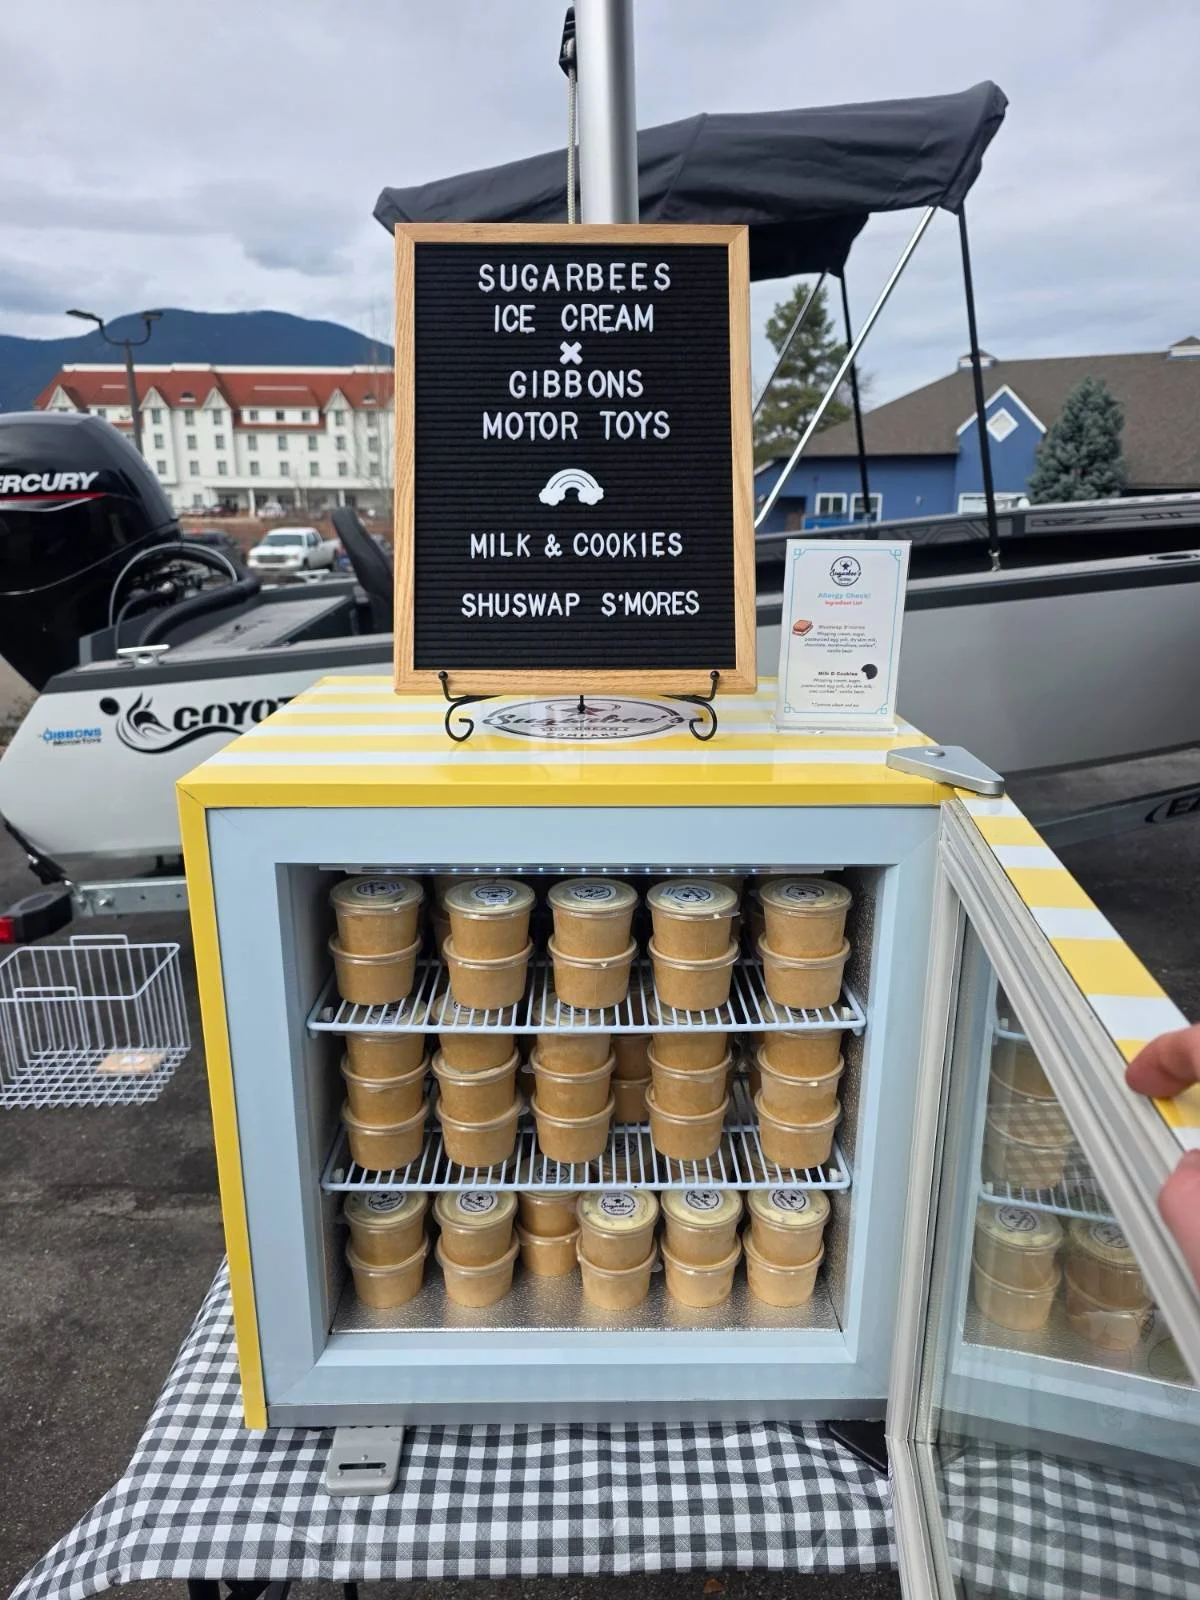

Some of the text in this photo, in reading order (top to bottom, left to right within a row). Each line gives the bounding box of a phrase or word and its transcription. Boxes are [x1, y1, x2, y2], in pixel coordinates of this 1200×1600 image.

[478, 262, 671, 294] SUGARBEES
[494, 303, 654, 334] ICE CREAM
[508, 369, 644, 399] GIBBONS
[482, 410, 671, 441] MOTOR TOYS
[0, 471, 99, 494] RCURY
[470, 531, 683, 559] MILK & COOKIES
[461, 590, 700, 619] SHUSWAP S'MORES
[43, 727, 101, 741] GIBBONS
